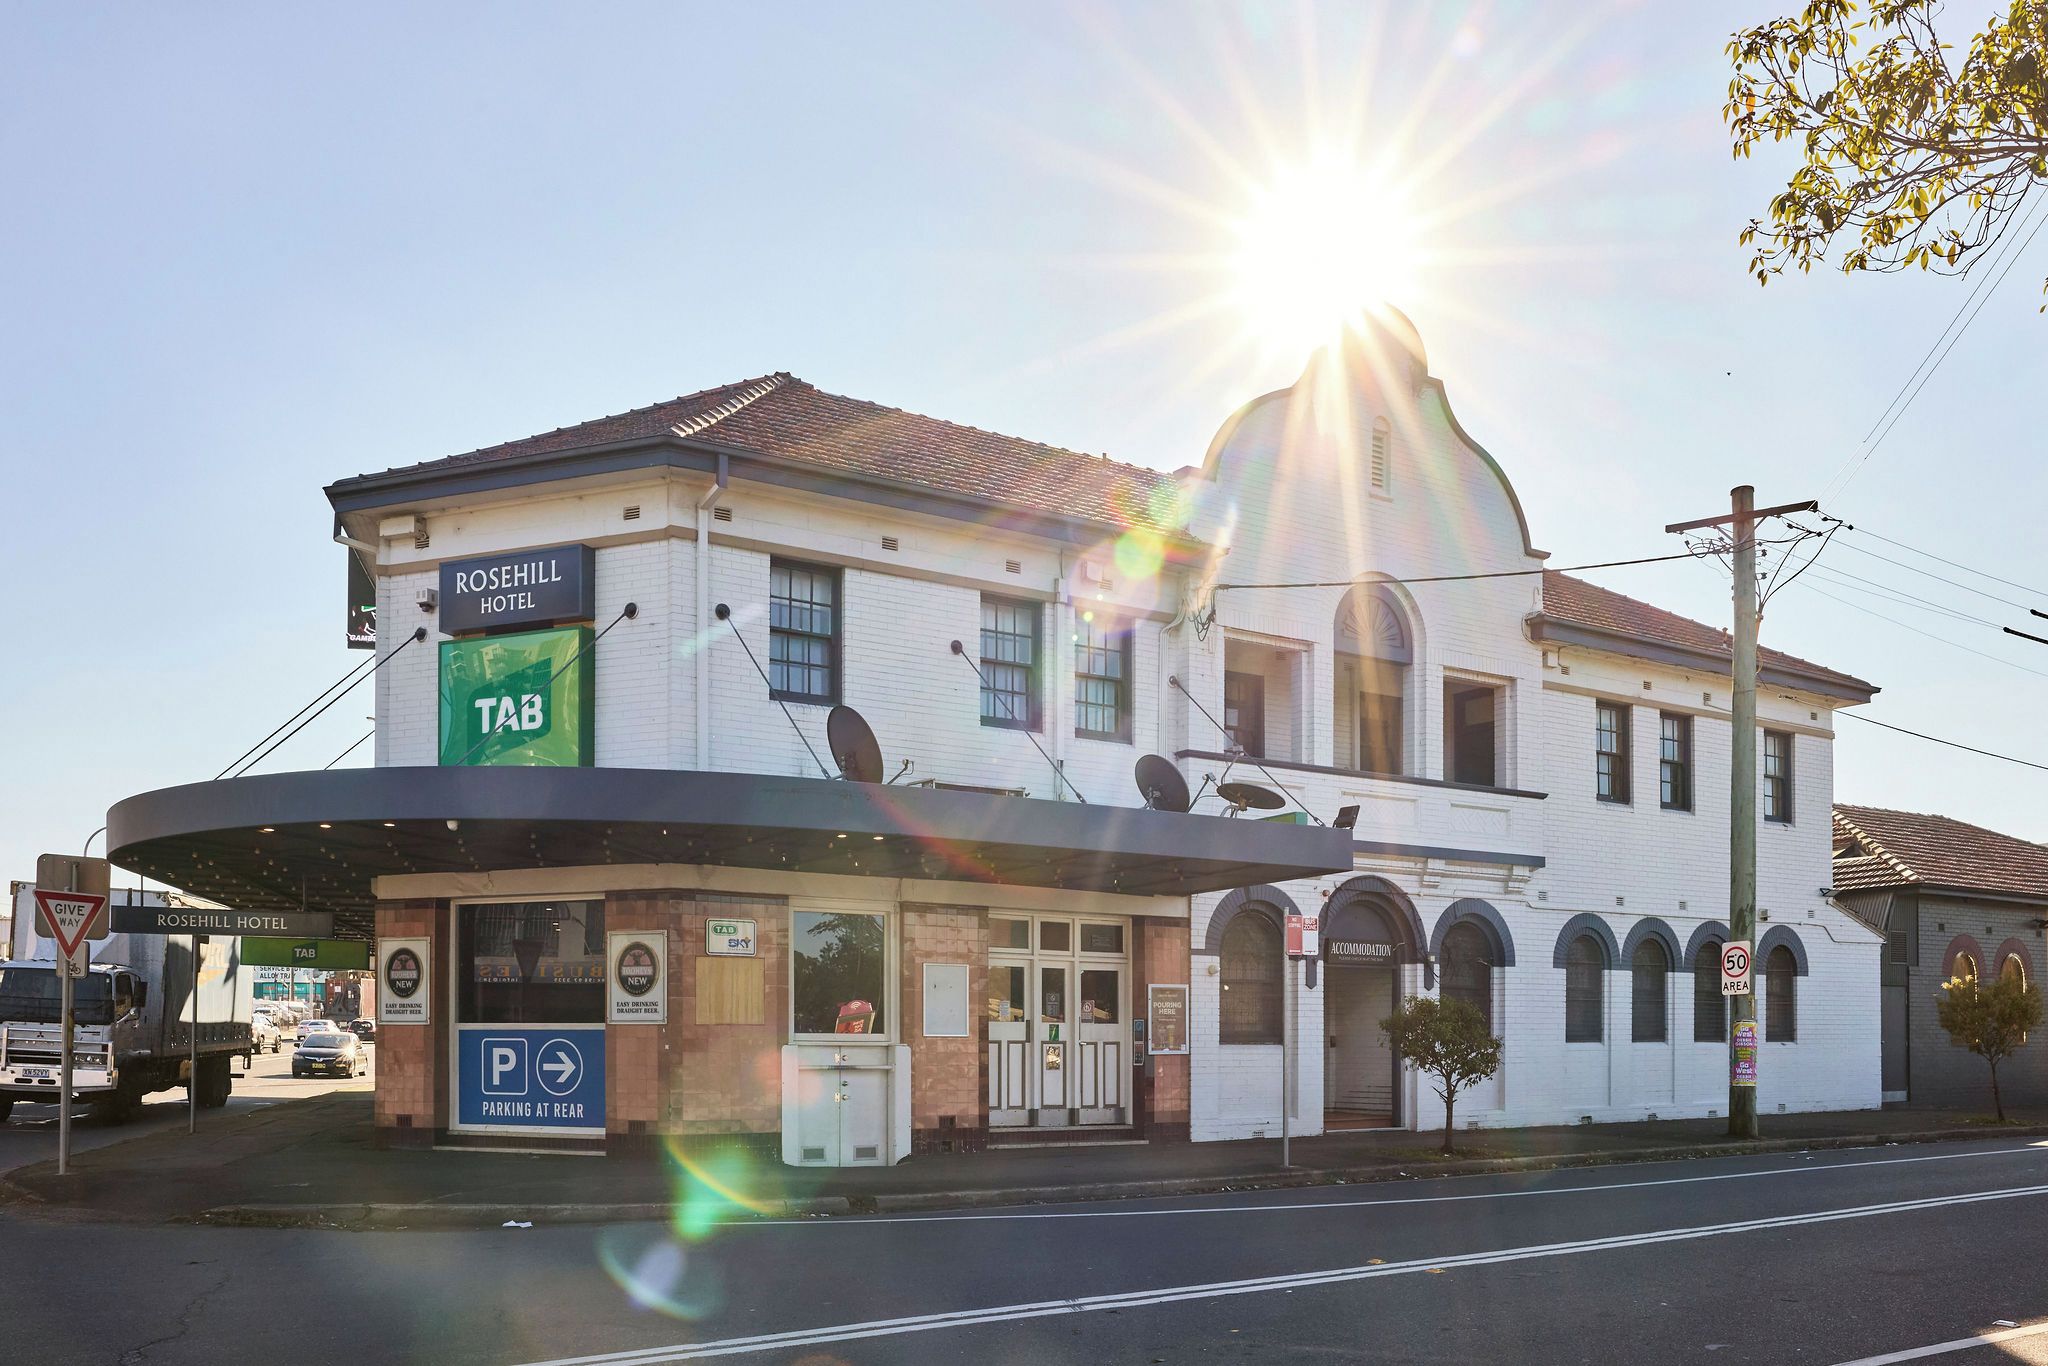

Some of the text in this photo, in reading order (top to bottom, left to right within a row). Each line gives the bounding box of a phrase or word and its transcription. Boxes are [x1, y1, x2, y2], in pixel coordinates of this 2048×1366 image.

[456, 559, 562, 594] ROSEHILL
[480, 592, 536, 614] HOTEL
[474, 694, 543, 734] TAB
[55, 903, 85, 916] GIVE
[60, 917, 80, 928] WAY
[157, 914, 288, 930] ROSEHILL HOTEL
[728, 938, 751, 948] SKY
[1330, 942, 1392, 957] ACCOMMODATION
[294, 948, 316, 958] TAB
[1727, 955, 1746, 970] 50
[396, 980, 413, 989] NEW
[628, 977, 648, 986] NEW
[1723, 981, 1749, 991] AREA
[492, 1047, 517, 1086] P
[482, 1101, 584, 1118] PARKING AT REAR
